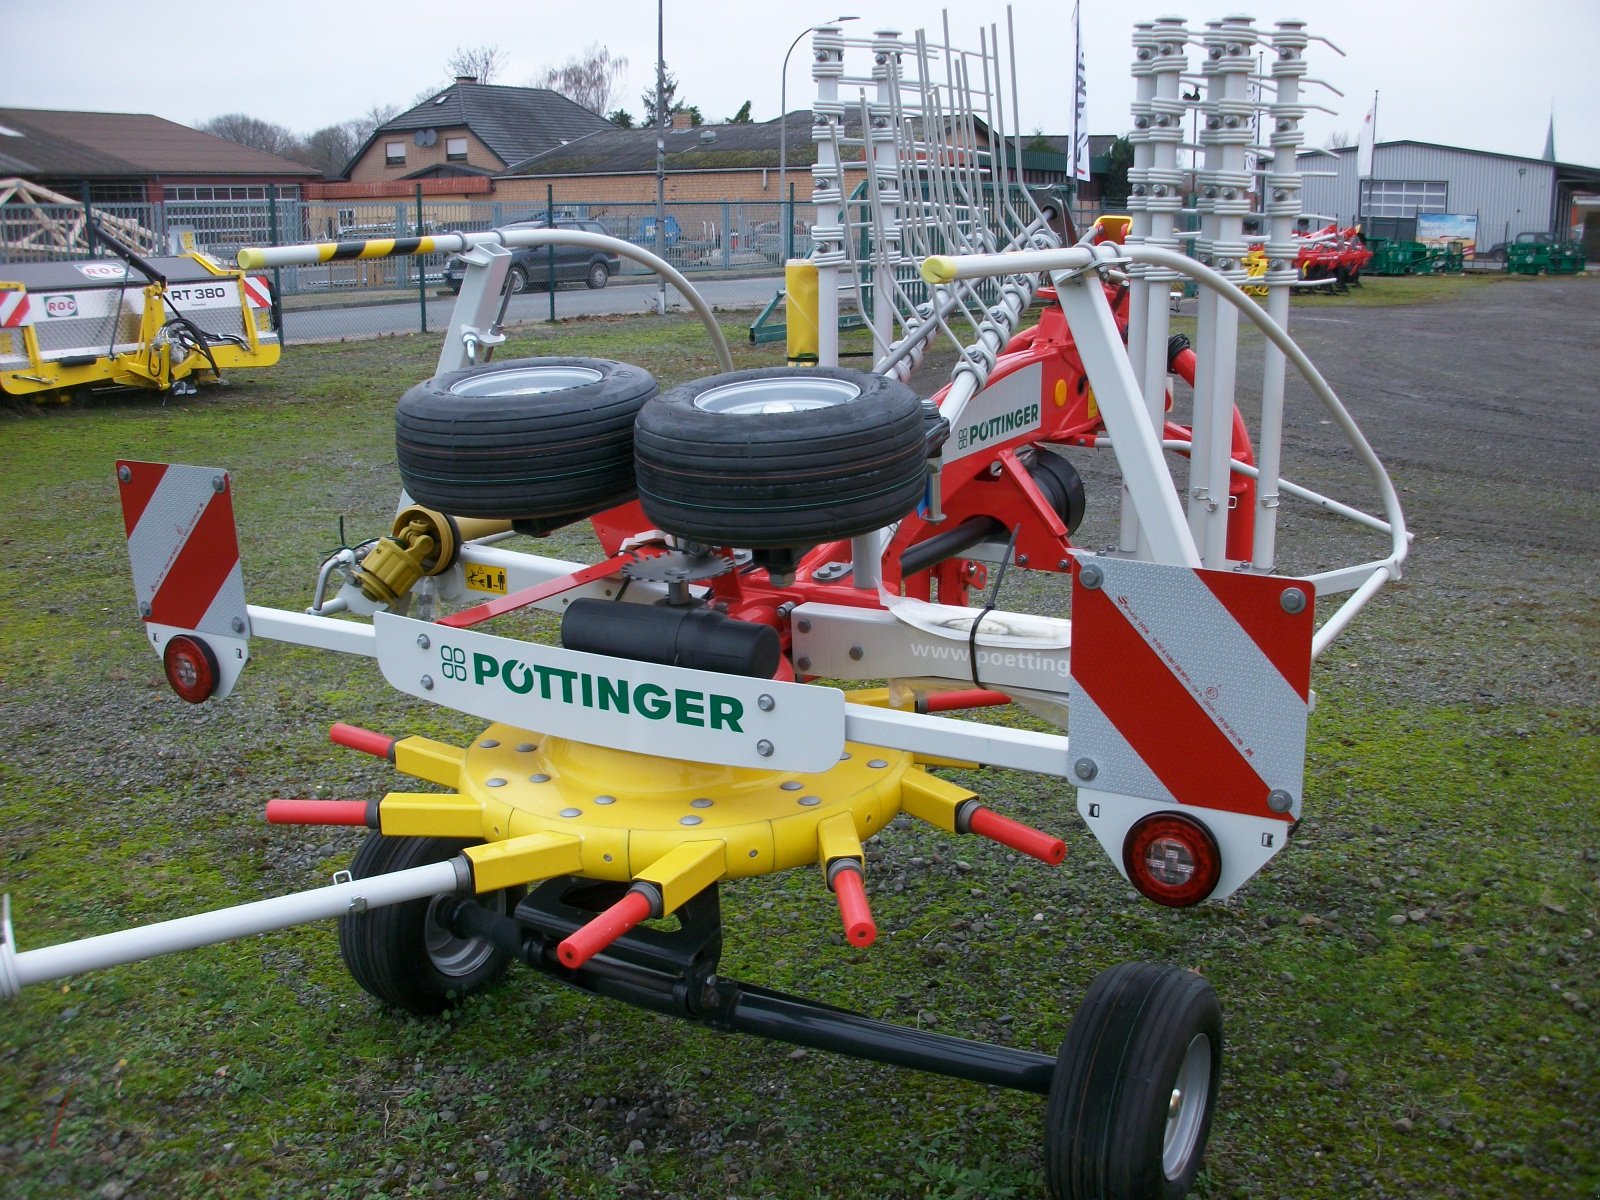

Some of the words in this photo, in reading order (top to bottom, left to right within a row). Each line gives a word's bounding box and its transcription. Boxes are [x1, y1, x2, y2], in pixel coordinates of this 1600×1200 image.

[85, 267, 124, 276] ROC
[171, 290, 191, 301] RT
[194, 287, 226, 300] 380
[48, 301, 76, 312] ROC
[473, 652, 745, 734] PÖTTINGER
